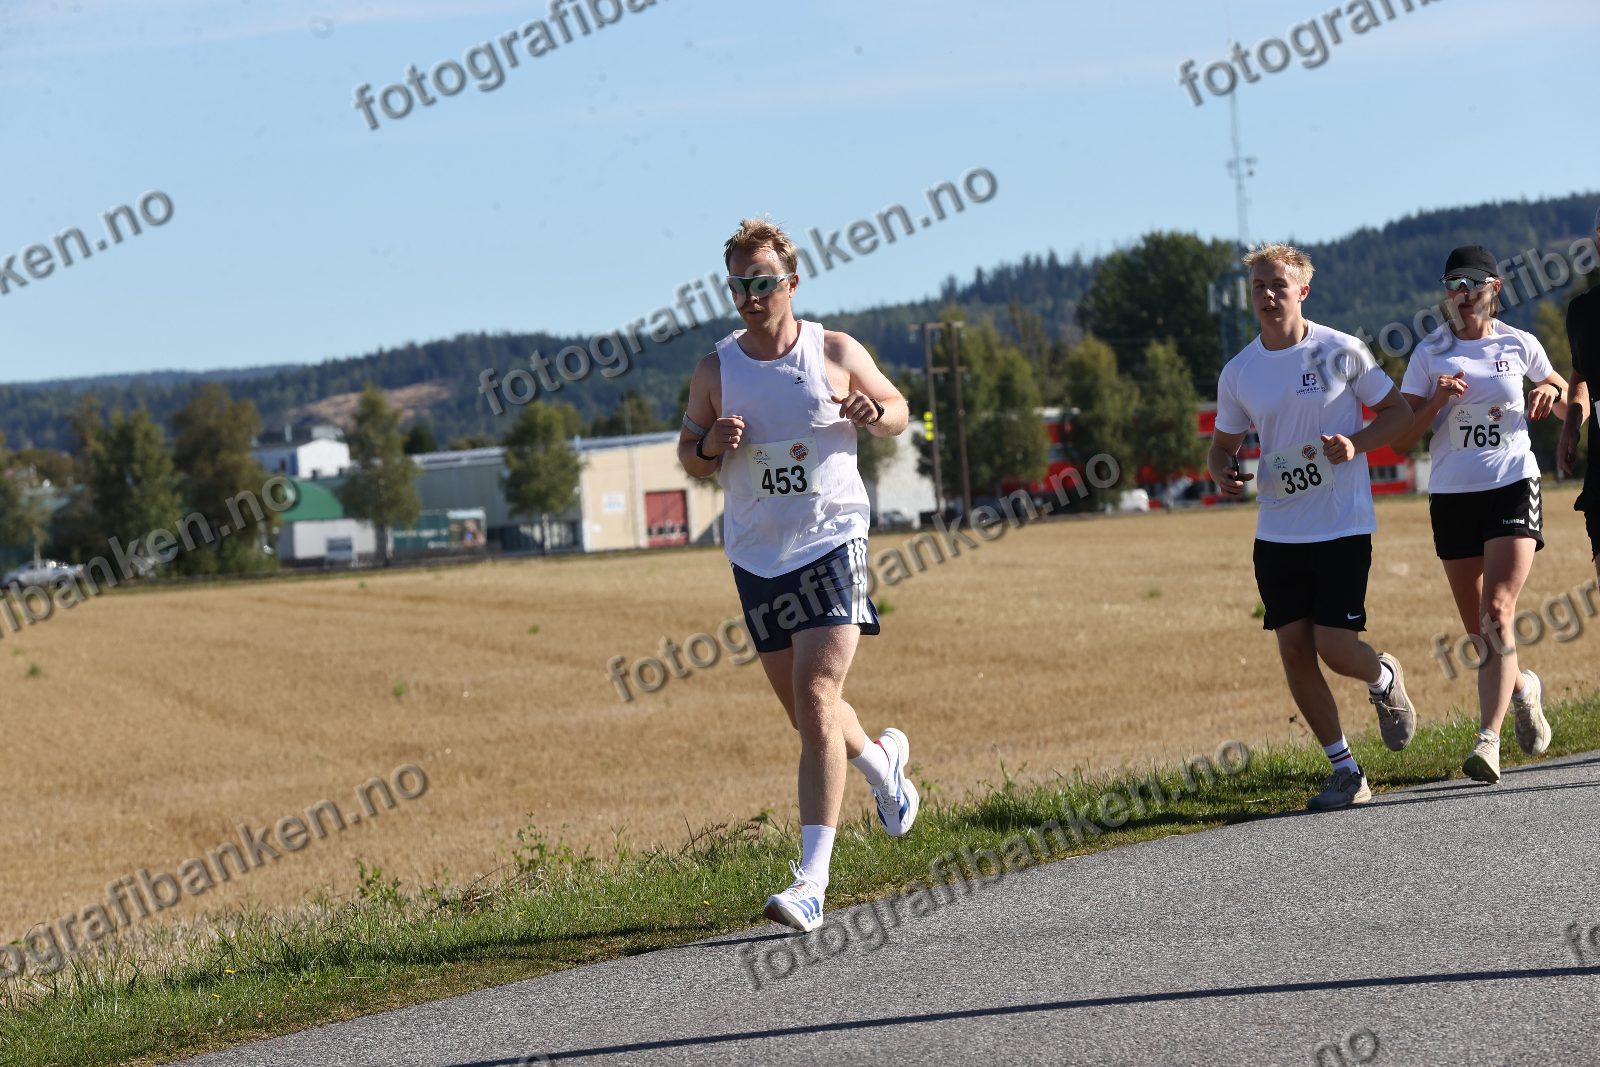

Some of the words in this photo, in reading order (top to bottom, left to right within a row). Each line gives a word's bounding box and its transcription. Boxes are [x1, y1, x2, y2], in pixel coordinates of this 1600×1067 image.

[1459, 424, 1501, 448] 765
[761, 465, 807, 494] 453
[1281, 463, 1322, 494] 338
